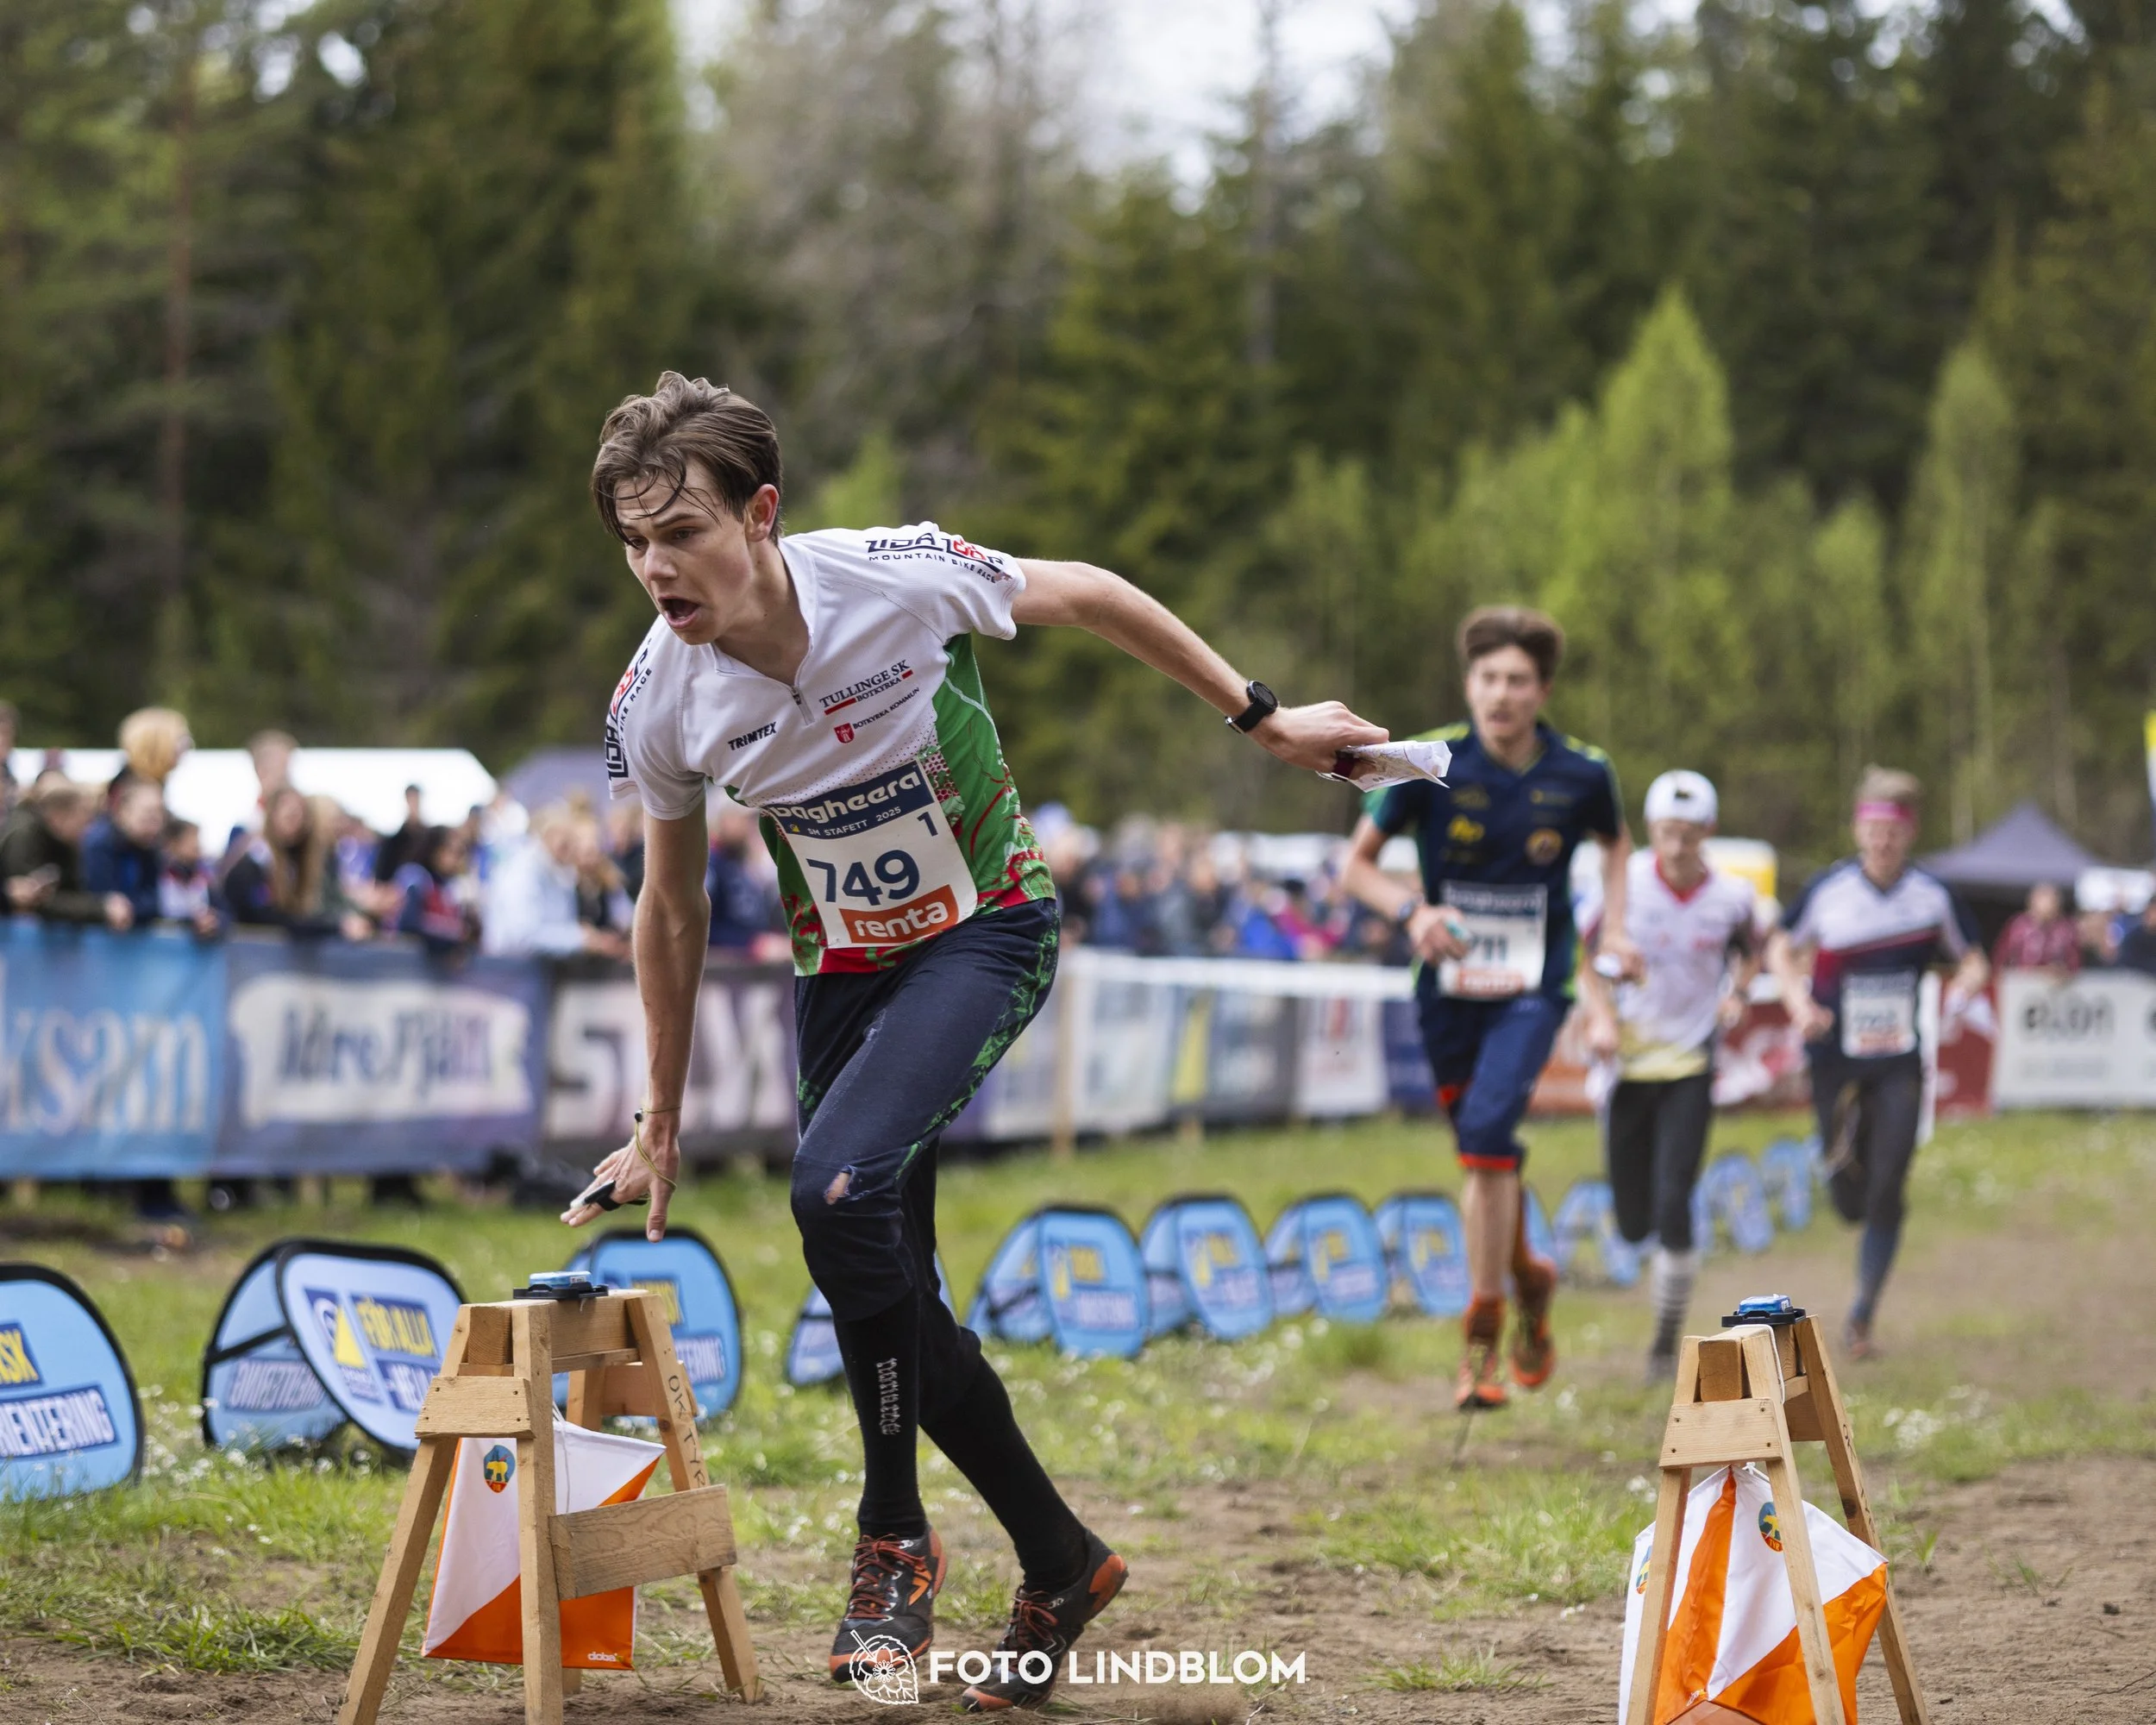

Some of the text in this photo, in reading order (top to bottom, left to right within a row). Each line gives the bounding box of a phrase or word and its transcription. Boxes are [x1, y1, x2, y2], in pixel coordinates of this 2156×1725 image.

[868, 553, 996, 584] MOUNTAIN BIKE RACE
[630, 667, 653, 703] RACE
[818, 659, 912, 709] TULLINGE SK
[856, 677, 902, 703] BOTKYRKA
[852, 687, 920, 730] BOTKYRKA KOMMUN
[727, 721, 777, 751] TRIMTEX
[807, 805, 902, 837] SM STAFETT 2025
[917, 811, 939, 837] 1
[805, 849, 921, 906] 749
[854, 901, 950, 938] renta
[0, 1328, 40, 1384] SK
[667, 1375, 687, 1420] OK
